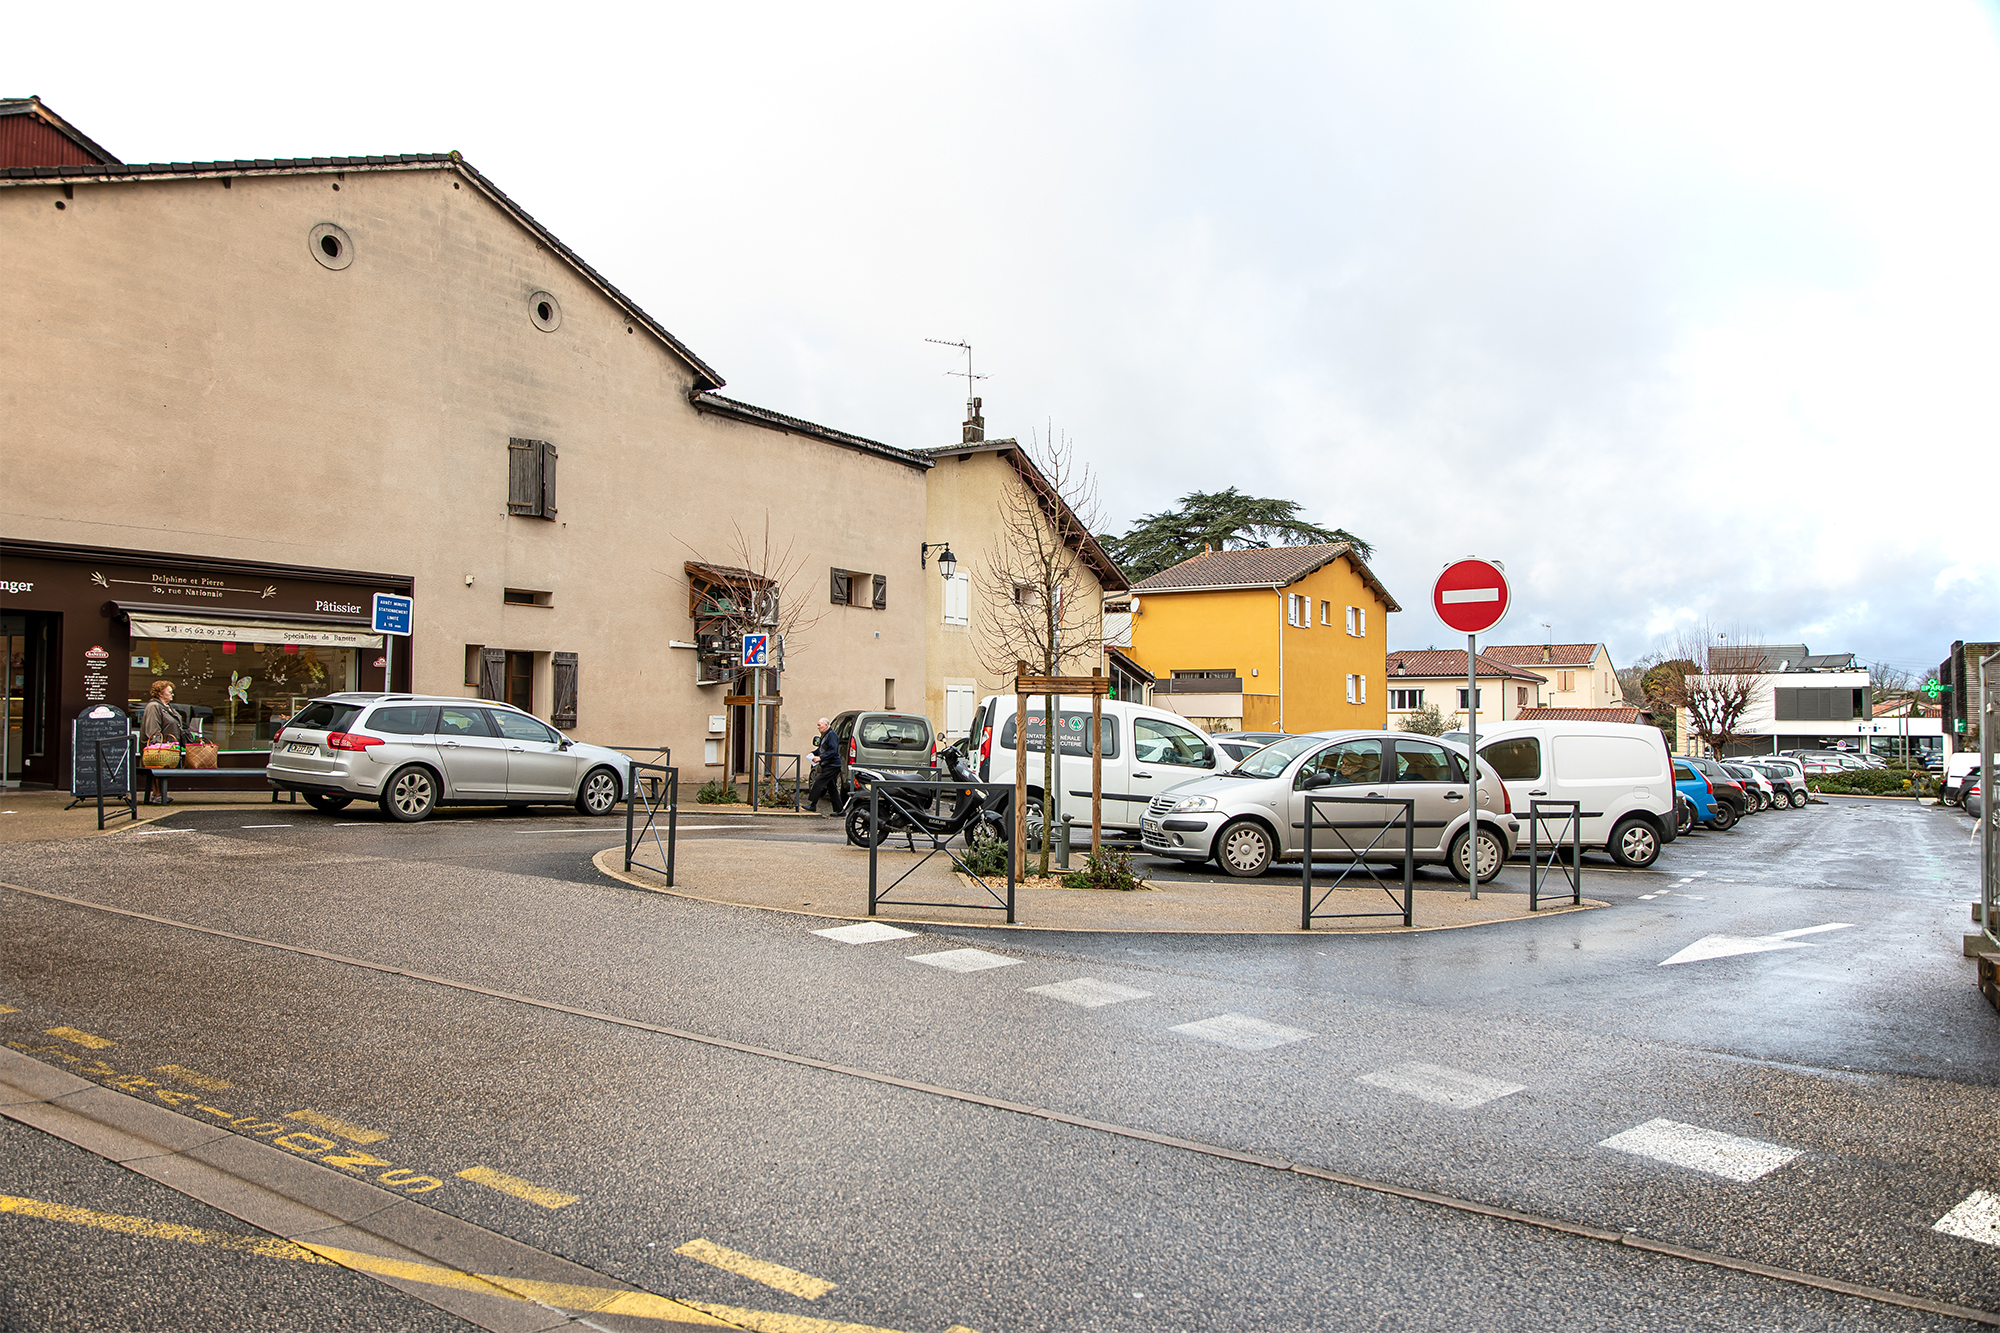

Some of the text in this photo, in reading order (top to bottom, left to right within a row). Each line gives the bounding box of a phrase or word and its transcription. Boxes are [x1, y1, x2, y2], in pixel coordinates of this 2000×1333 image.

[152, 574, 187, 584] Delphine
[201, 577, 225, 587] Pierre
[152, 586, 165, 594] 30,
[185, 588, 223, 597] Nationale
[315, 600, 361, 614] Pâtissier
[378, 607, 409, 615] STATIONNEMENT
[165, 625, 177, 633] Tél
[283, 632, 318, 641] Spécialités
